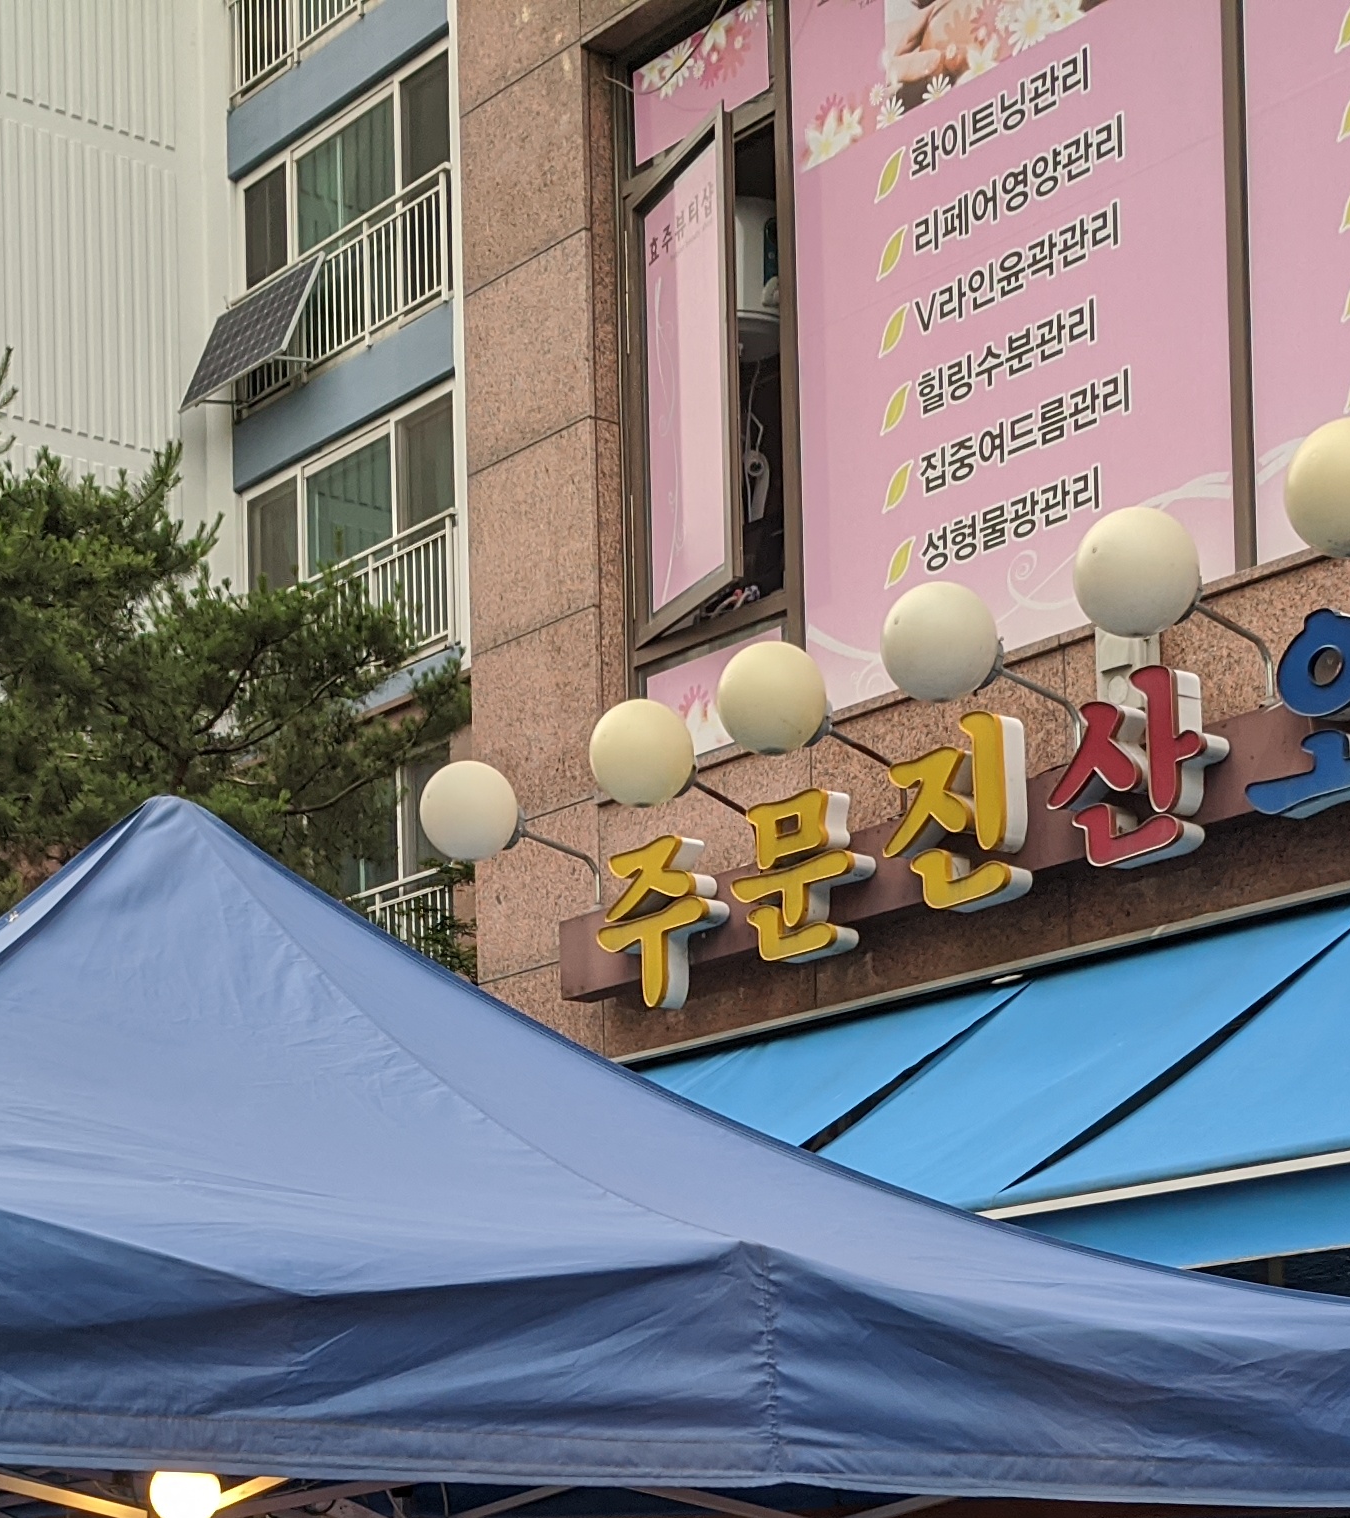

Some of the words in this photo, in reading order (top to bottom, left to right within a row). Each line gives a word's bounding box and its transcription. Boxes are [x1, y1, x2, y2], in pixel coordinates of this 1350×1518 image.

[911, 46, 1089, 177] 화이트닝관리
[914, 113, 1124, 252] 리페어영양관리
[914, 201, 1119, 333] V라인윤곽관리
[918, 297, 1095, 415] 힐링수분관리
[920, 367, 1130, 494] 집중여드름관리
[921, 465, 1100, 572] 성형물광관리
